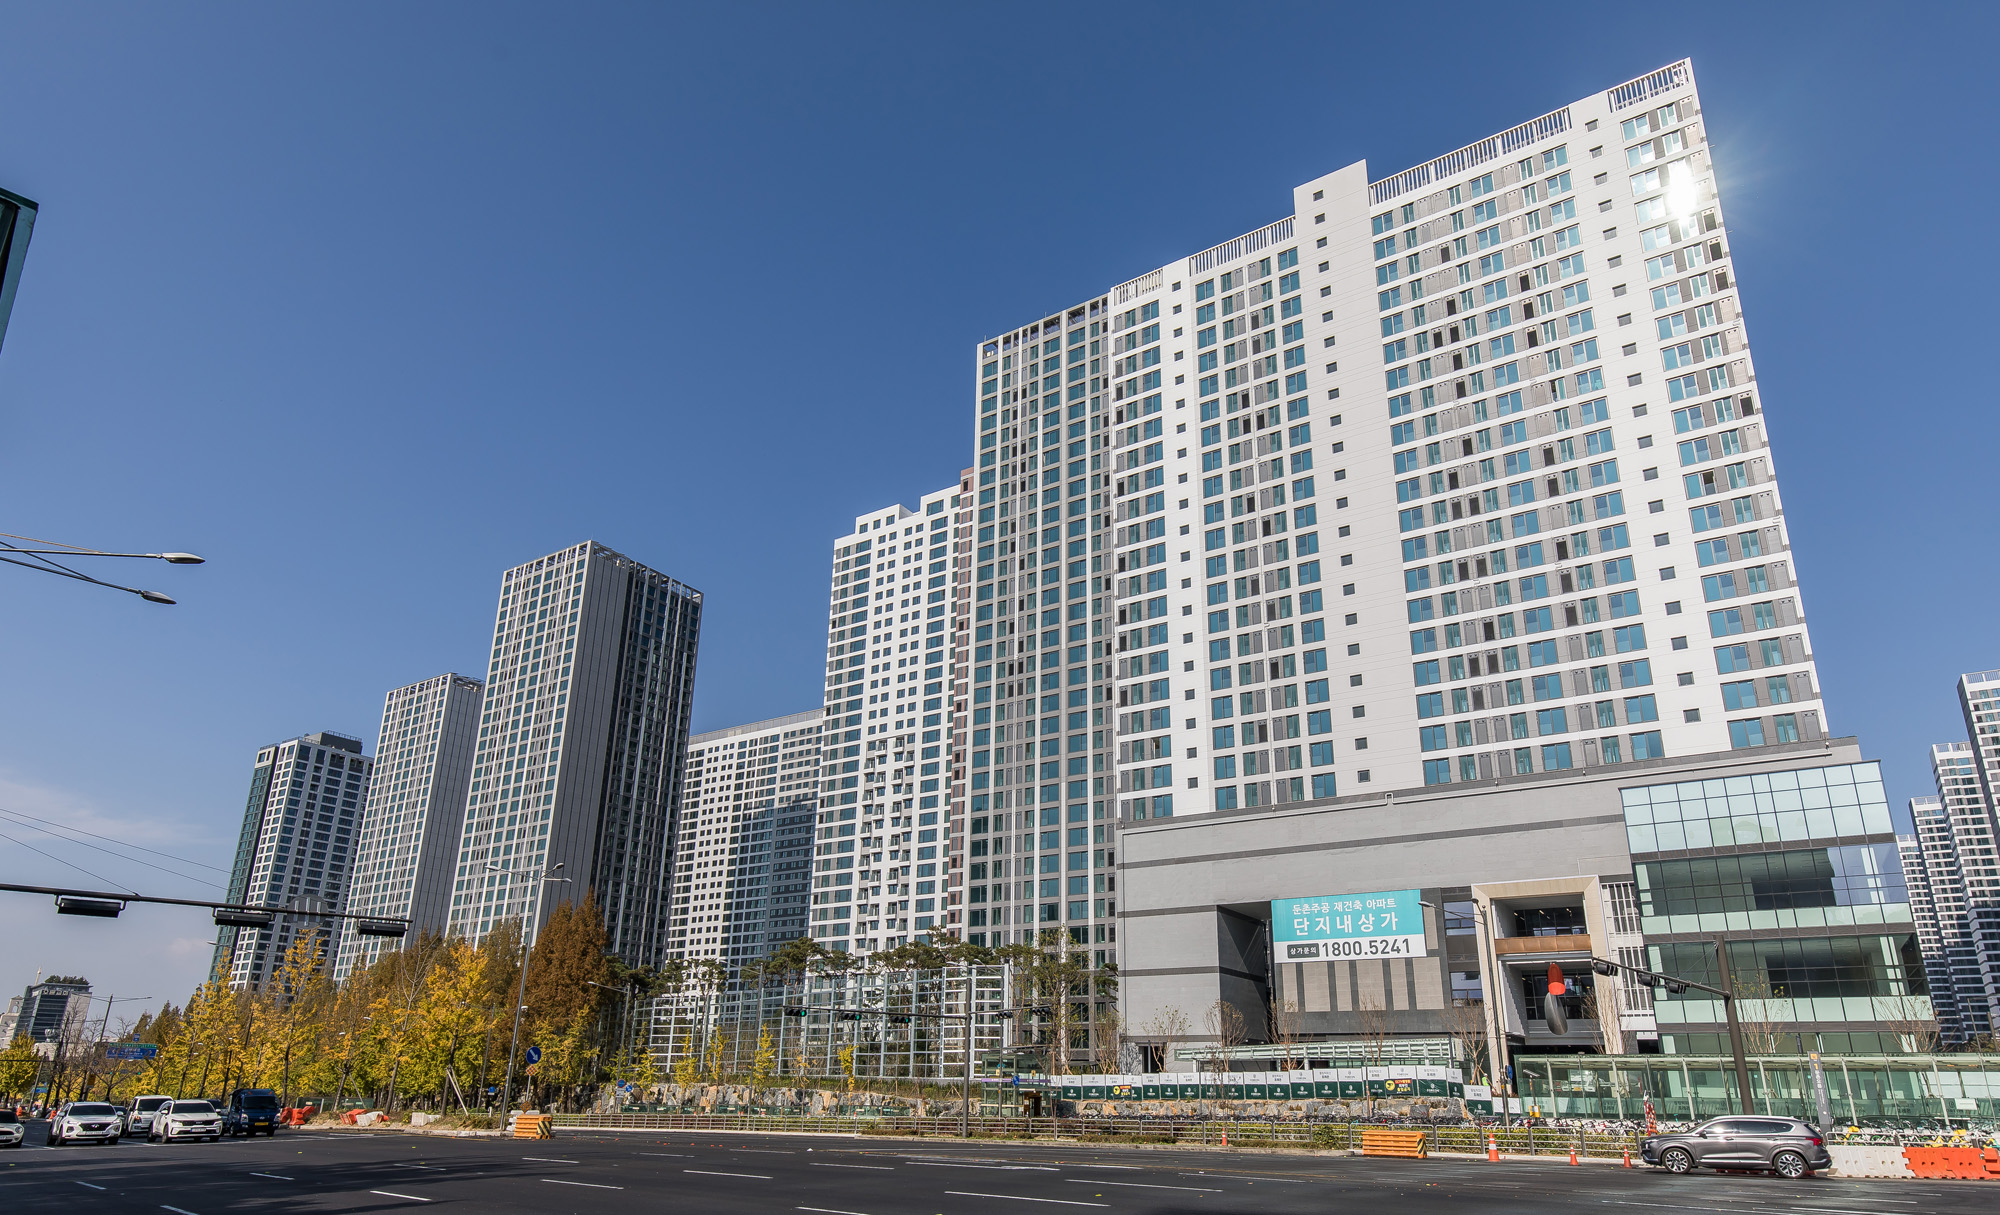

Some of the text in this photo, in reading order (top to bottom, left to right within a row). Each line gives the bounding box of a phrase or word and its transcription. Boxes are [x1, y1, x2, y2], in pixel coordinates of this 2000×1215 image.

[1292, 898, 1397, 914] 둔촌주공 재건축 아파트
[1290, 946, 1316, 955] 상가문의
[1322, 938, 1410, 957] 1800.5241
